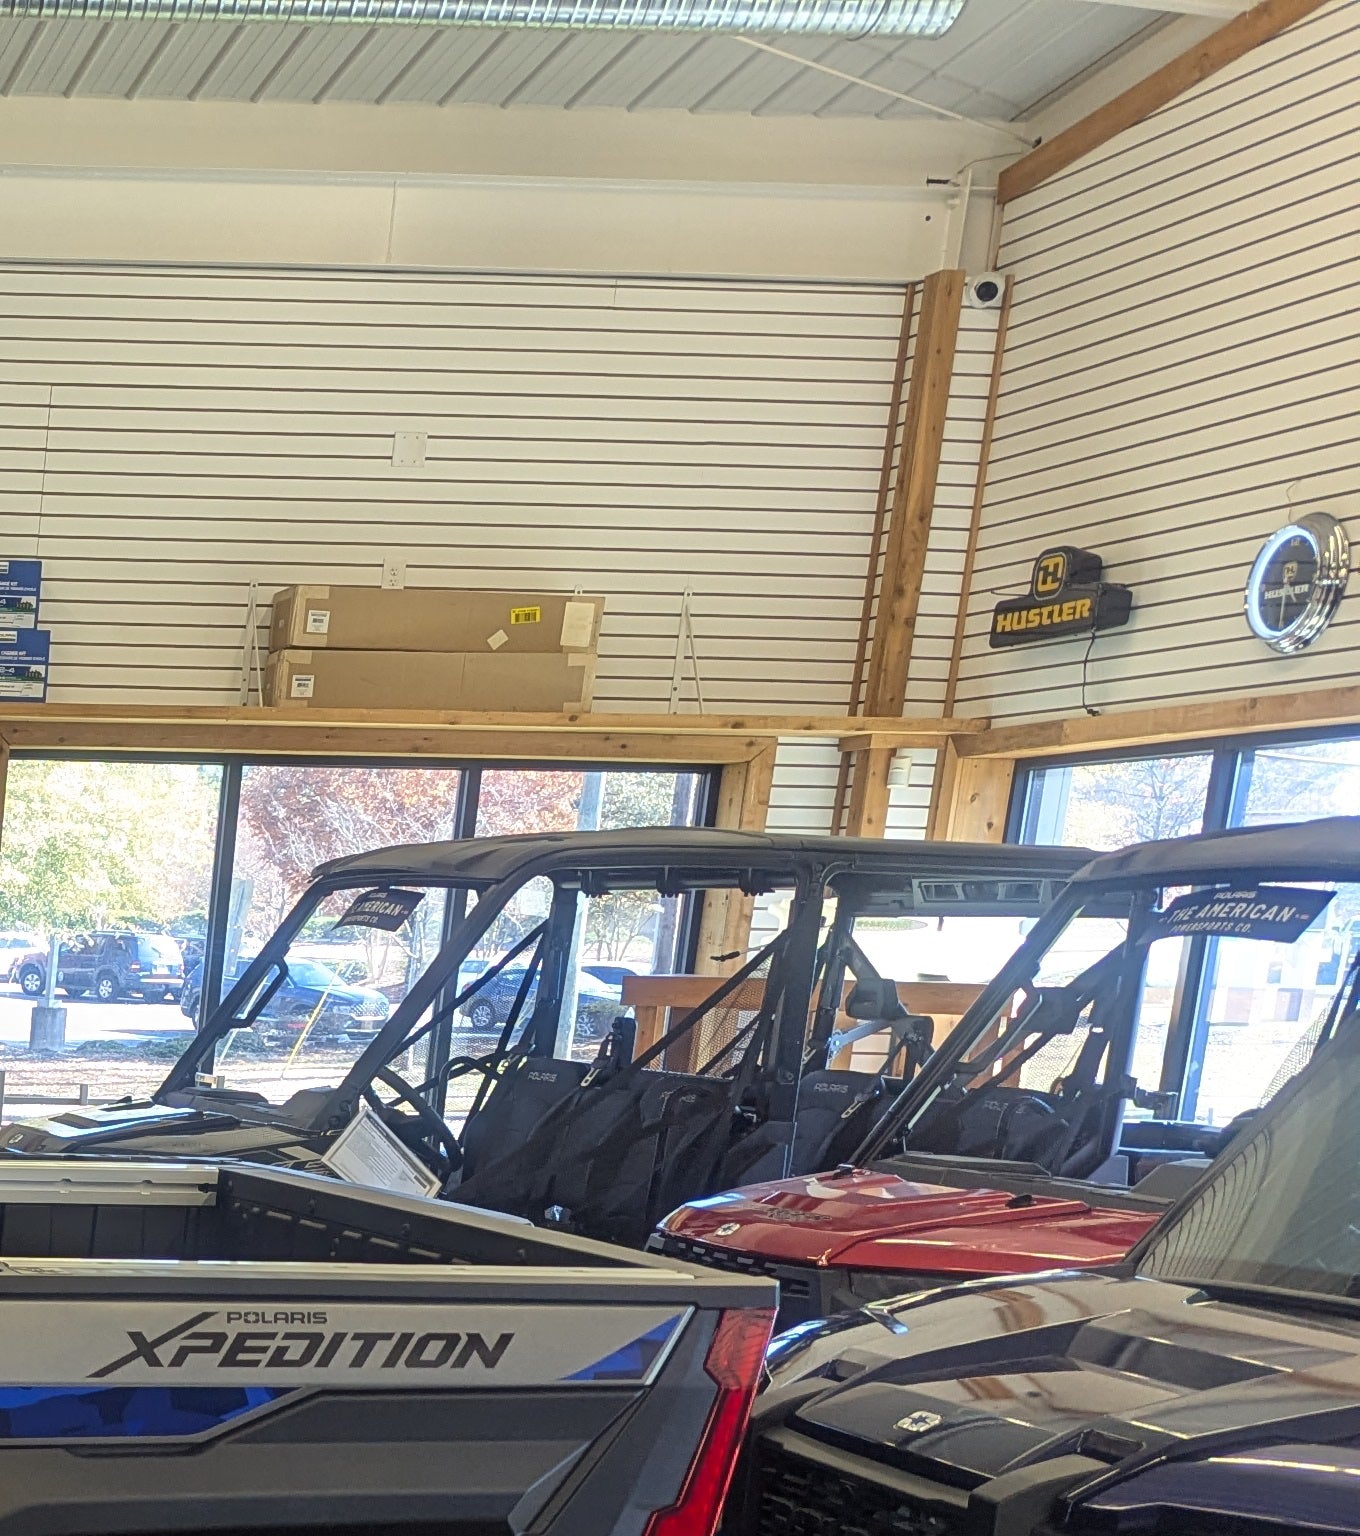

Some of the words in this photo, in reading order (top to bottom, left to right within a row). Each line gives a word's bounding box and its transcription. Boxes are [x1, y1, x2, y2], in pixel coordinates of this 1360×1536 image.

[996, 598, 1091, 633] HUSTLER
[1214, 891, 1258, 900] POLARIS
[1167, 905, 1200, 924] THE
[1194, 902, 1297, 923] AMERICAN
[226, 1311, 329, 1325] POLARIS
[85, 1311, 516, 1379] XPEDITION
